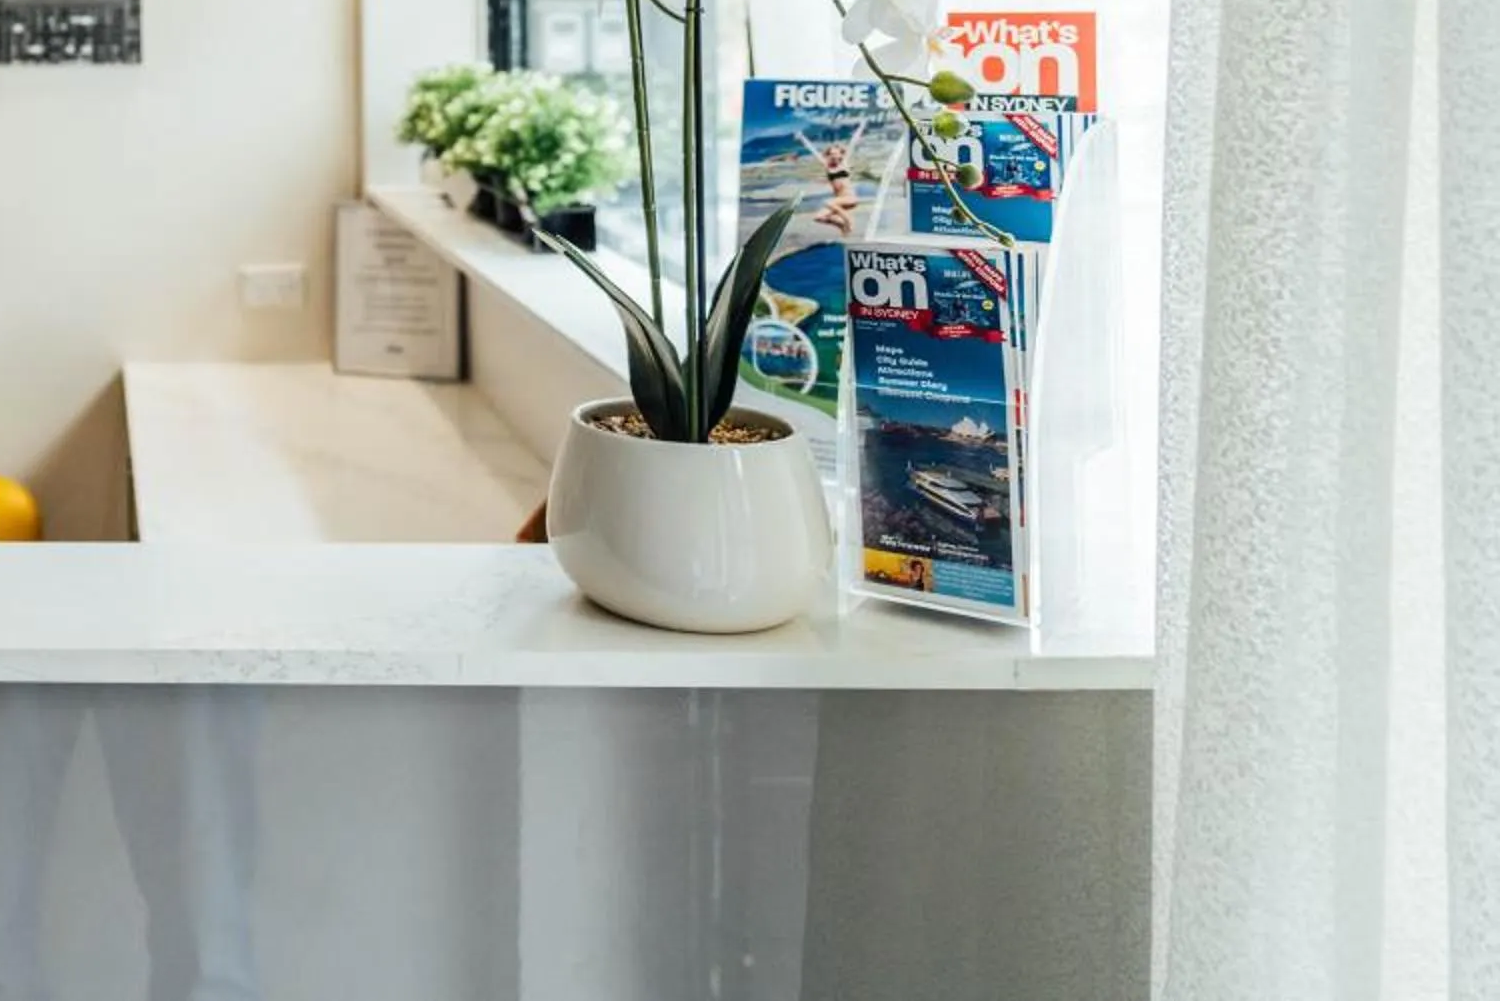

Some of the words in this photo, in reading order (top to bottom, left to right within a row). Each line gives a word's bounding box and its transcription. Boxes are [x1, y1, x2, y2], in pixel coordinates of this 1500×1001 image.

[963, 19, 1079, 44] What's
[966, 43, 1079, 96] on
[774, 84, 870, 108] FIGURE
[992, 97, 1069, 111] SYDNEY
[851, 252, 927, 272] What's
[852, 268, 929, 309] on
[859, 307, 873, 317] IN
[874, 308, 919, 320] SYDNEY
[875, 344, 904, 355] Maps
[876, 355, 897, 367] City
